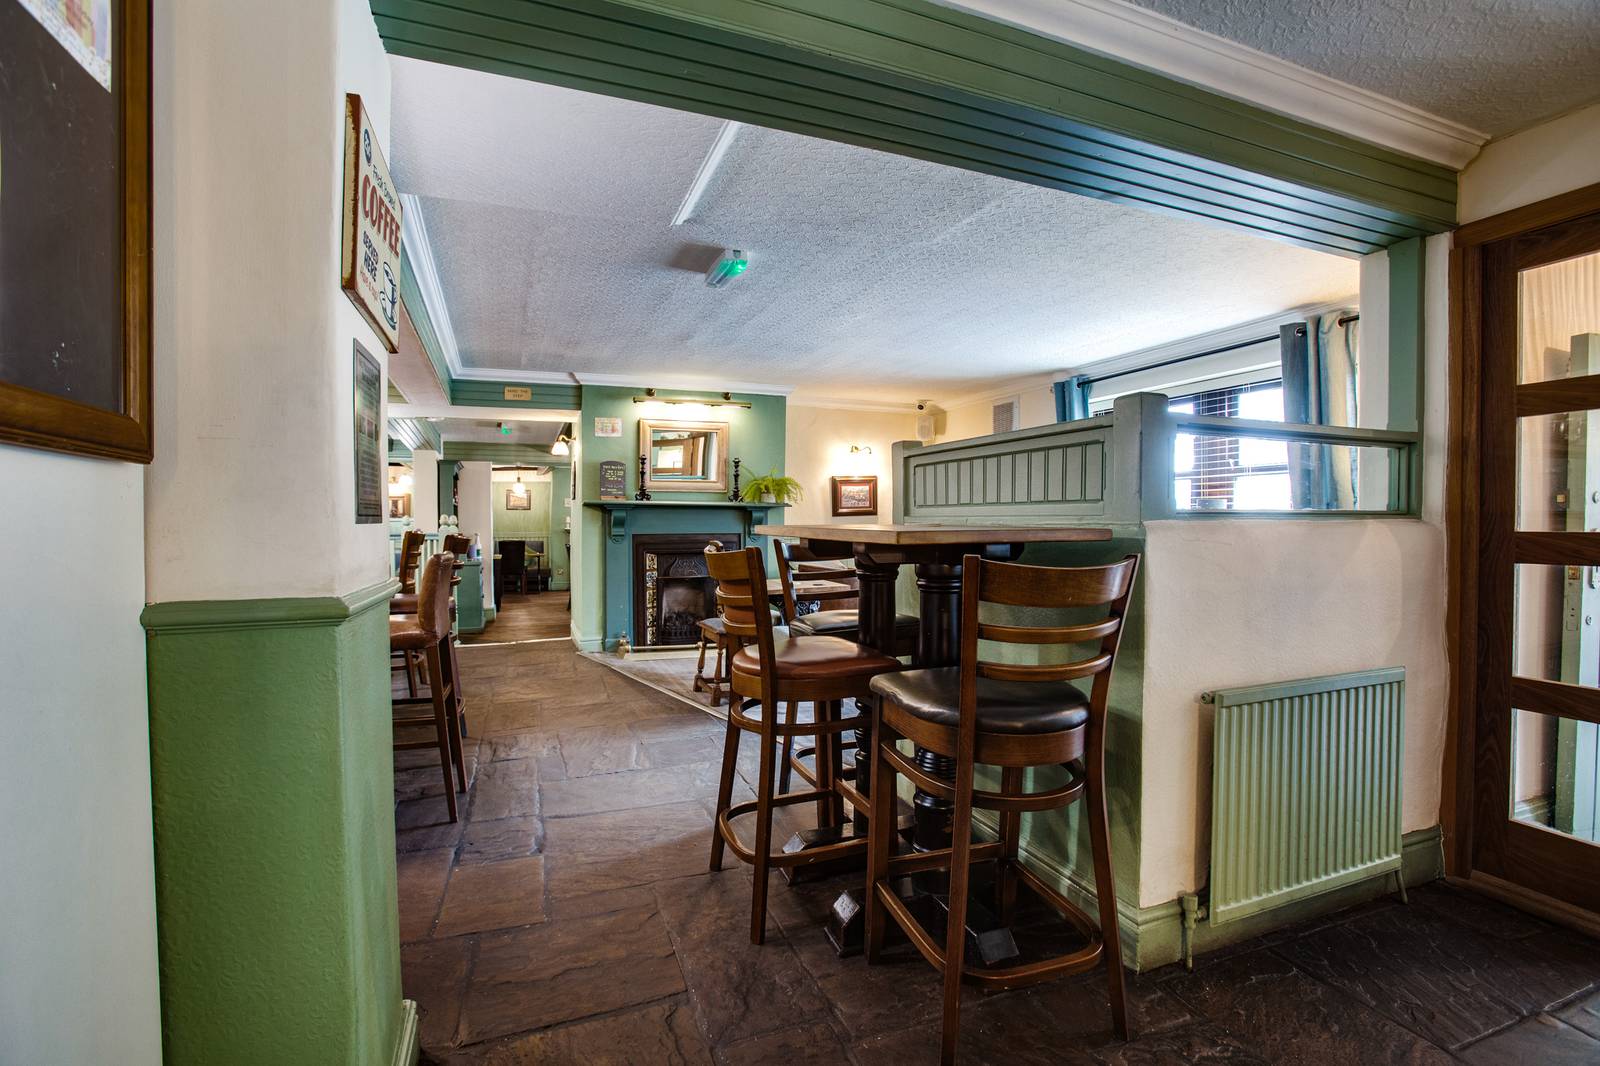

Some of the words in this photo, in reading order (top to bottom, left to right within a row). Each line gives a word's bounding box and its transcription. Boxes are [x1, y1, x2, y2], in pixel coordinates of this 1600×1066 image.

[362, 174, 400, 257] COFFEE
[363, 230, 379, 265] SERVED
[364, 250, 377, 282] HERE
